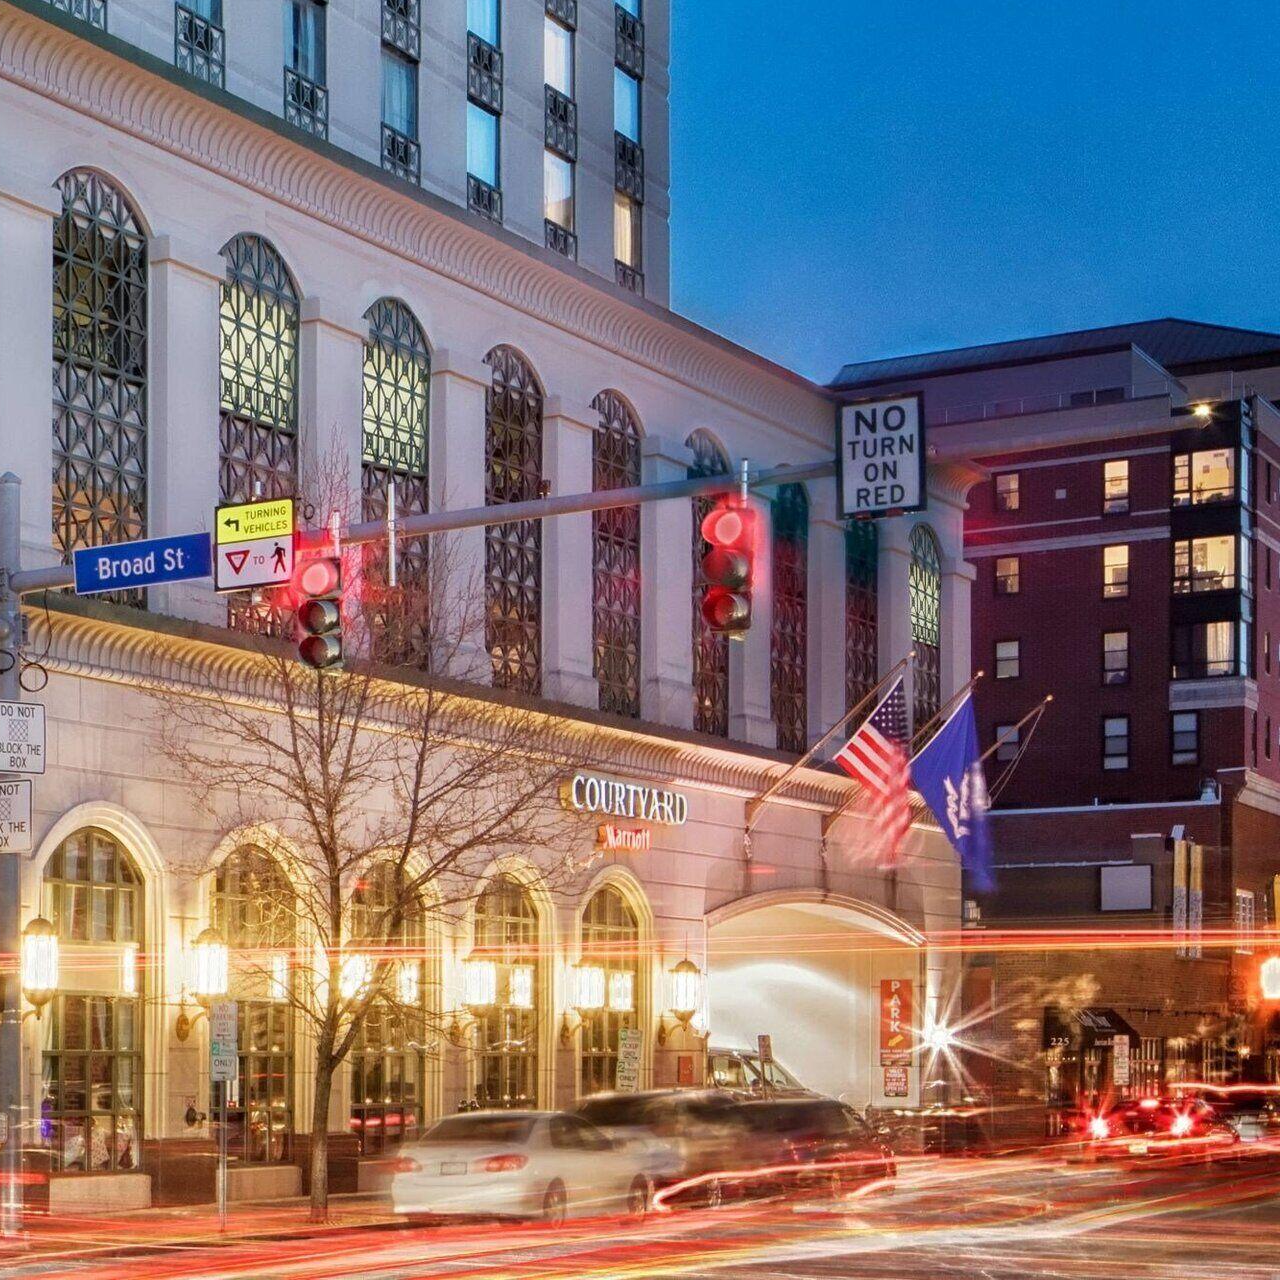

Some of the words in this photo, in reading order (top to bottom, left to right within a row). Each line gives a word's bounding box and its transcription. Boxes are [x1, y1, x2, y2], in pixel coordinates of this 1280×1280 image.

[855, 405, 906, 436] NO
[847, 433, 914, 460] TURN
[864, 460, 897, 482] ON
[856, 484, 905, 508] RED
[245, 506, 287, 521] TURNING
[243, 520, 288, 534] VEHICLES
[98, 551, 155, 580] Broad
[163, 547, 184, 571] St
[253, 555, 265, 565] TO
[0, 705, 14, 717] DO
[17, 706, 36, 718] NOT
[26, 743, 41, 756] THE
[9, 756, 27, 768] BOX
[572, 775, 688, 825] COURTYARD
[8, 821, 26, 834] THE
[603, 823, 650, 851] Marriott
[889, 980, 902, 1032] PARK
[1050, 1037, 1070, 1046] 225
